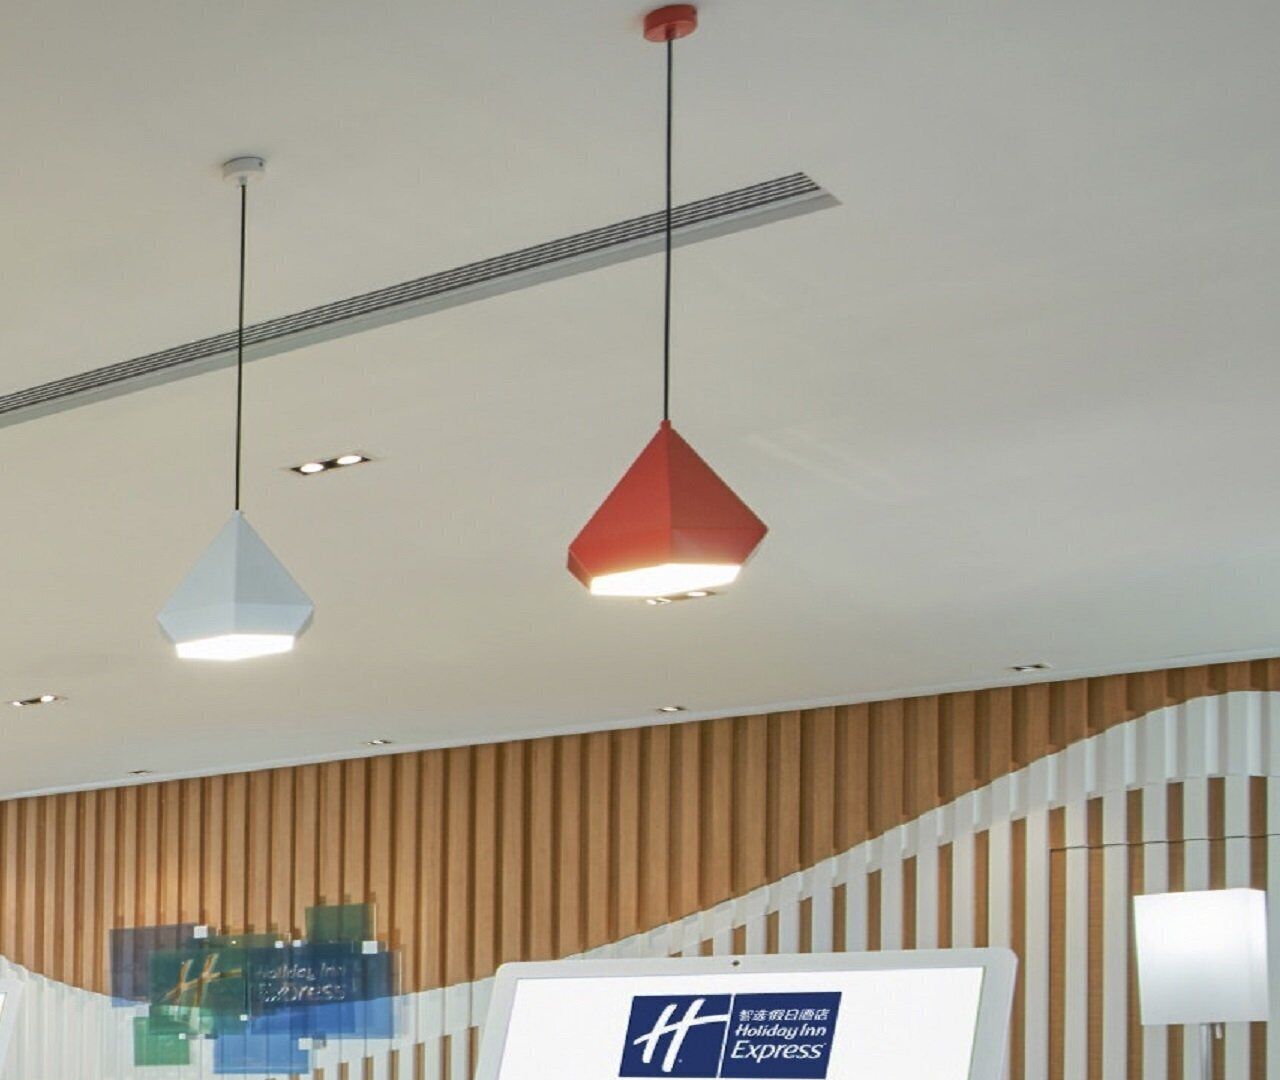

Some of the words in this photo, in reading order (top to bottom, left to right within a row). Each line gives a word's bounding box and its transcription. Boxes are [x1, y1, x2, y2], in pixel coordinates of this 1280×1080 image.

[734, 1023, 798, 1040] Holiday
[799, 1023, 827, 1036] Inn
[730, 1040, 824, 1063] Express
